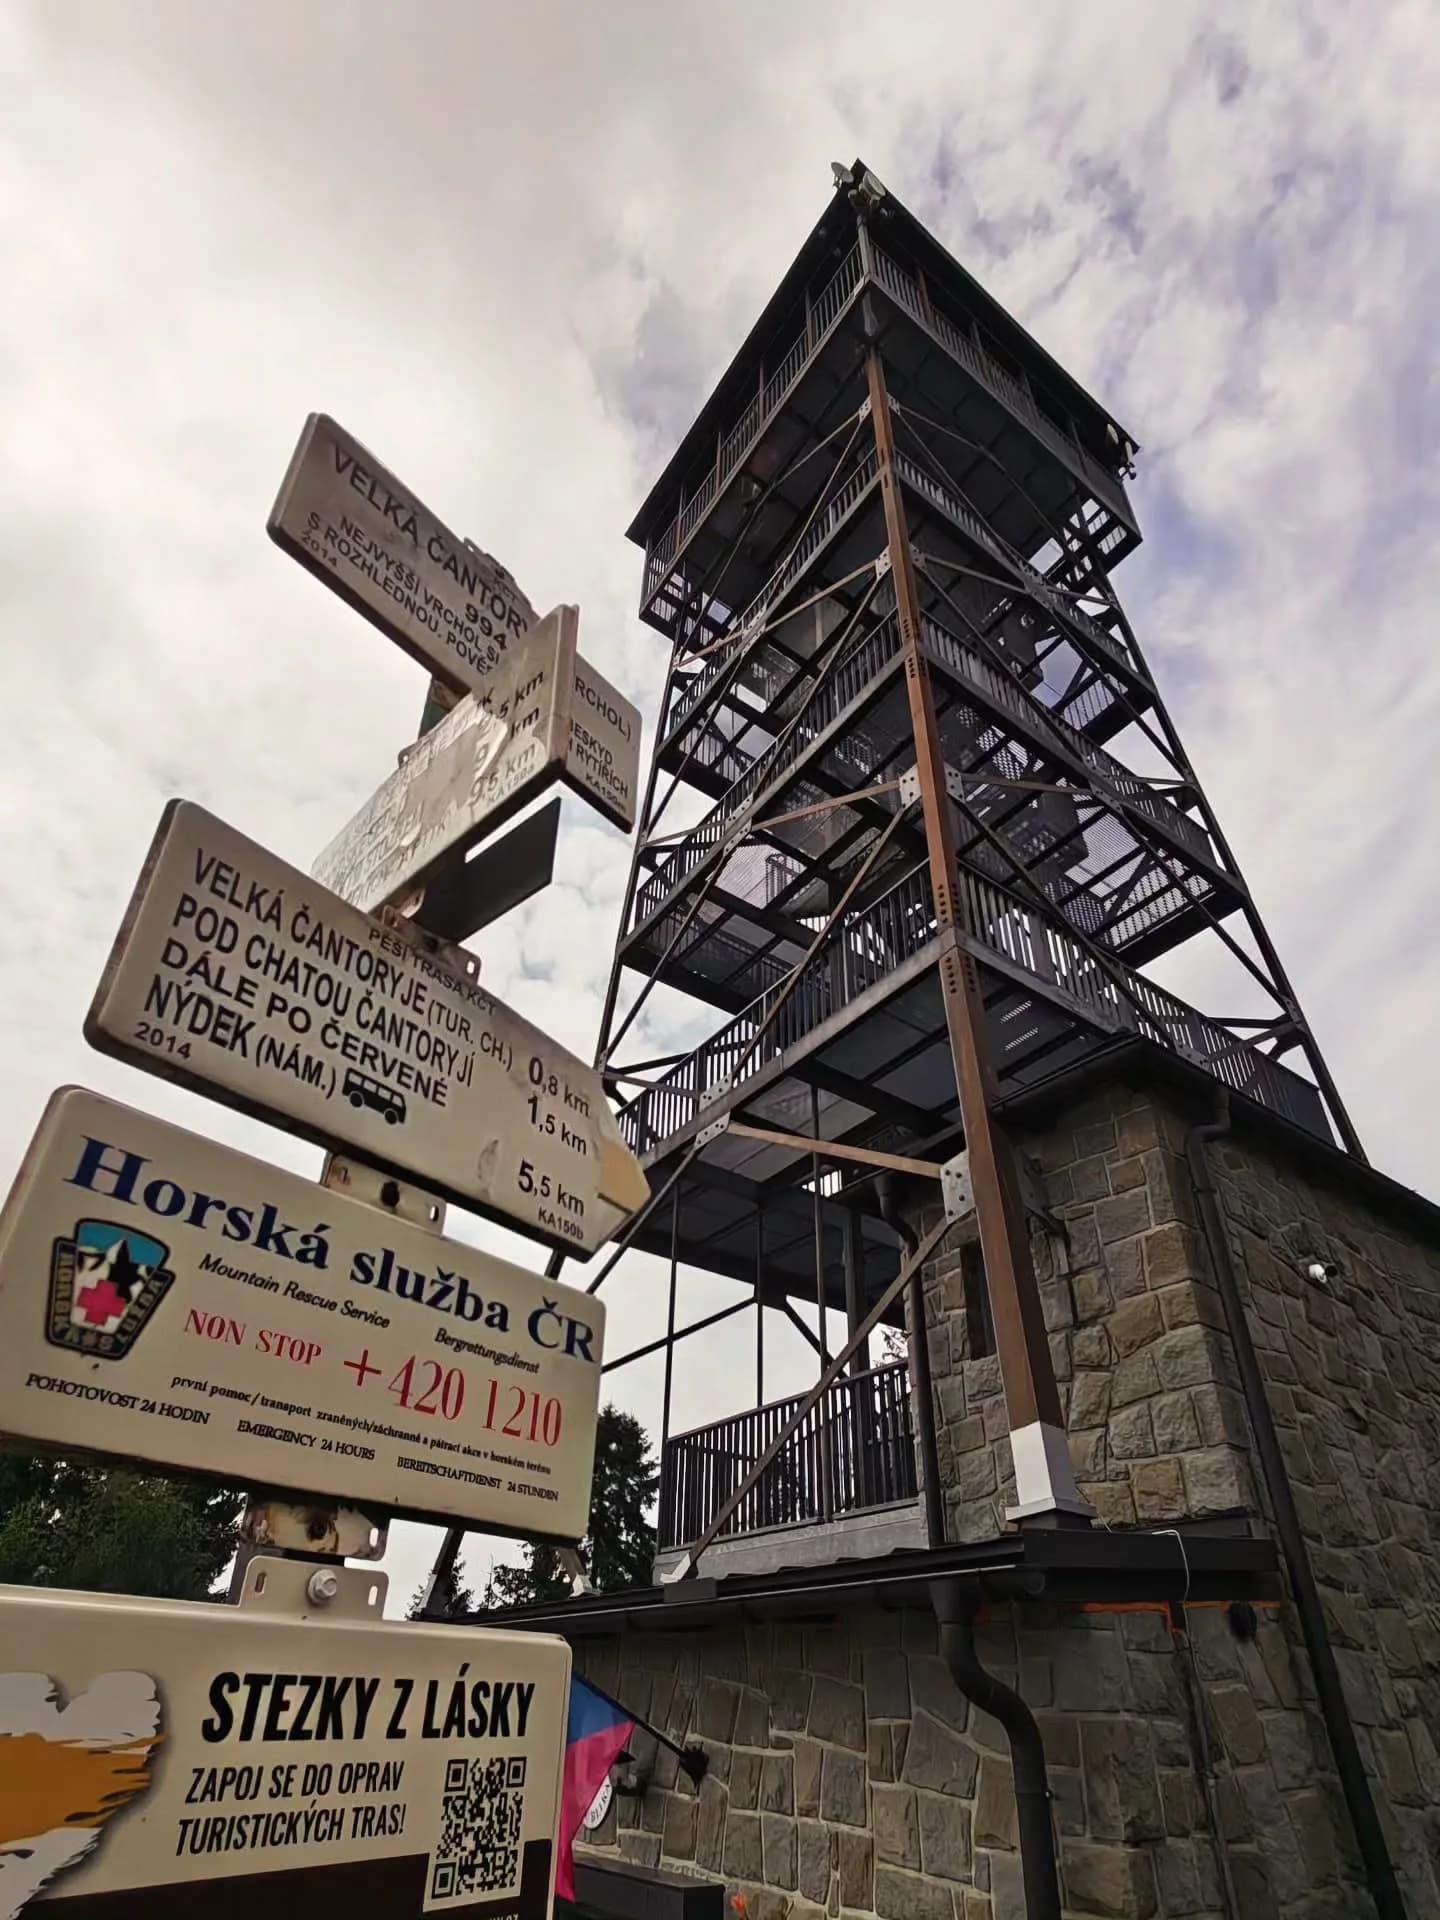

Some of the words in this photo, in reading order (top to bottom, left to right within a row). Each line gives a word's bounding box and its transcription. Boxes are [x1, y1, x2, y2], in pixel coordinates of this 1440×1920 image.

[308, 512, 321, 530] S
[334, 447, 419, 546] VELKÁ
[302, 529, 338, 567] 2014
[340, 515, 420, 595] NEJVYŠŠÍ
[424, 587, 482, 651] VRCHOL
[465, 603, 507, 650] 994
[515, 672, 544, 708] km
[511, 707, 540, 739] km
[506, 744, 535, 779] km
[194, 848, 285, 932] VELKÁ
[291, 904, 427, 1015] ČANTORYJE
[428, 999, 474, 1045] (TUR.
[481, 1032, 513, 1073] CH.)
[529, 1057, 557, 1096] 0,8
[564, 1085, 590, 1118] km
[412, 955, 464, 997] TRASA
[133, 1022, 192, 1059] 2014
[161, 938, 259, 1008] DÁLE
[266, 992, 311, 1034] PO
[321, 1016, 448, 1107] ČERVENÉ
[172, 892, 239, 953] POD
[245, 934, 351, 1017] CHATOU
[356, 989, 476, 1088] ČANTORYJÍ
[528, 1095, 555, 1135] 1,5
[561, 1123, 587, 1155] km
[144, 973, 256, 1058] NÝDEK
[256, 1034, 336, 1099] (NÁM.)
[518, 1159, 551, 1198] 5,5
[557, 1184, 584, 1217] km
[62, 1134, 331, 1269] Horská
[350, 1248, 510, 1333] služba
[527, 1295, 598, 1363] ČR
[538, 1206, 584, 1240] KA150b
[198, 1253, 279, 1293] Mountain
[283, 1281, 338, 1312] Rescue
[340, 1299, 391, 1329] Service
[434, 1327, 540, 1374] Bergrettungsdienst
[171, 1375, 208, 1391] první
[209, 1384, 252, 1402] pomoc
[260, 1395, 311, 1416] transport
[183, 1308, 247, 1347] NON
[255, 1329, 322, 1365] STOP
[482, 1378, 562, 1447] 1210
[25, 1373, 139, 1410] POHOTOVOST
[139, 1399, 156, 1414] 24
[158, 1403, 210, 1425] HODIN
[237, 1419, 316, 1447] EMERGENCY
[320, 1438, 332, 1451] 24
[335, 1442, 375, 1460] HOURS
[507, 1481, 516, 1492] 24
[517, 1483, 559, 1502] STUNDEN
[201, 1671, 380, 1743] STEZKY
[385, 1678, 414, 1739] Z
[421, 1662, 535, 1739] LÁSKY
[185, 1765, 264, 1804] ZAPOJ
[268, 1764, 298, 1799] SE
[301, 1763, 332, 1797] DO
[338, 1761, 404, 1794] OPRAV
[175, 1800, 345, 1856] TURISTICKÝCH
[351, 1803, 407, 1839] TRAS!
